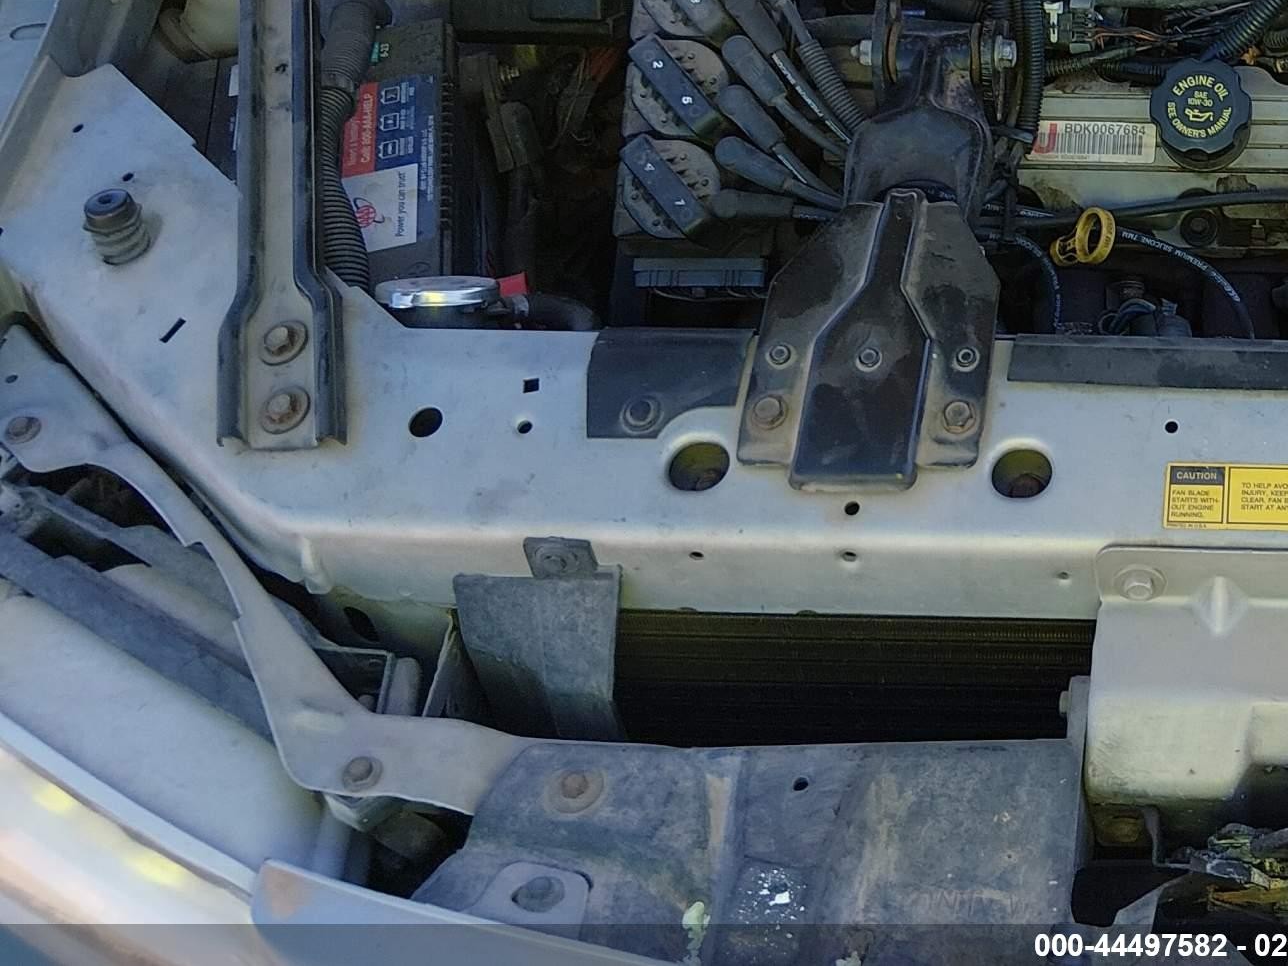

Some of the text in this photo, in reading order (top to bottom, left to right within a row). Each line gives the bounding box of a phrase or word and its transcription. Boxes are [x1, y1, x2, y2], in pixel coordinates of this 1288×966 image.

[652, 60, 664, 70] 2
[1172, 75, 1229, 102] ENGINE OIL
[1194, 90, 1208, 99] SAE
[1187, 97, 1213, 107] 10W-30
[1167, 101, 1232, 138] SEE OWNER'S MANUAL
[1032, 122, 1146, 154] J BDK0067684
[643, 162, 656, 172] 4
[398, 189, 406, 201] can
[397, 201, 407, 215] you
[395, 215, 405, 237] Power
[1141, 236, 1173, 253] SILICONE
[1174, 248, 1208, 271] PREMIUM
[1176, 471, 1217, 480] CAUTION
